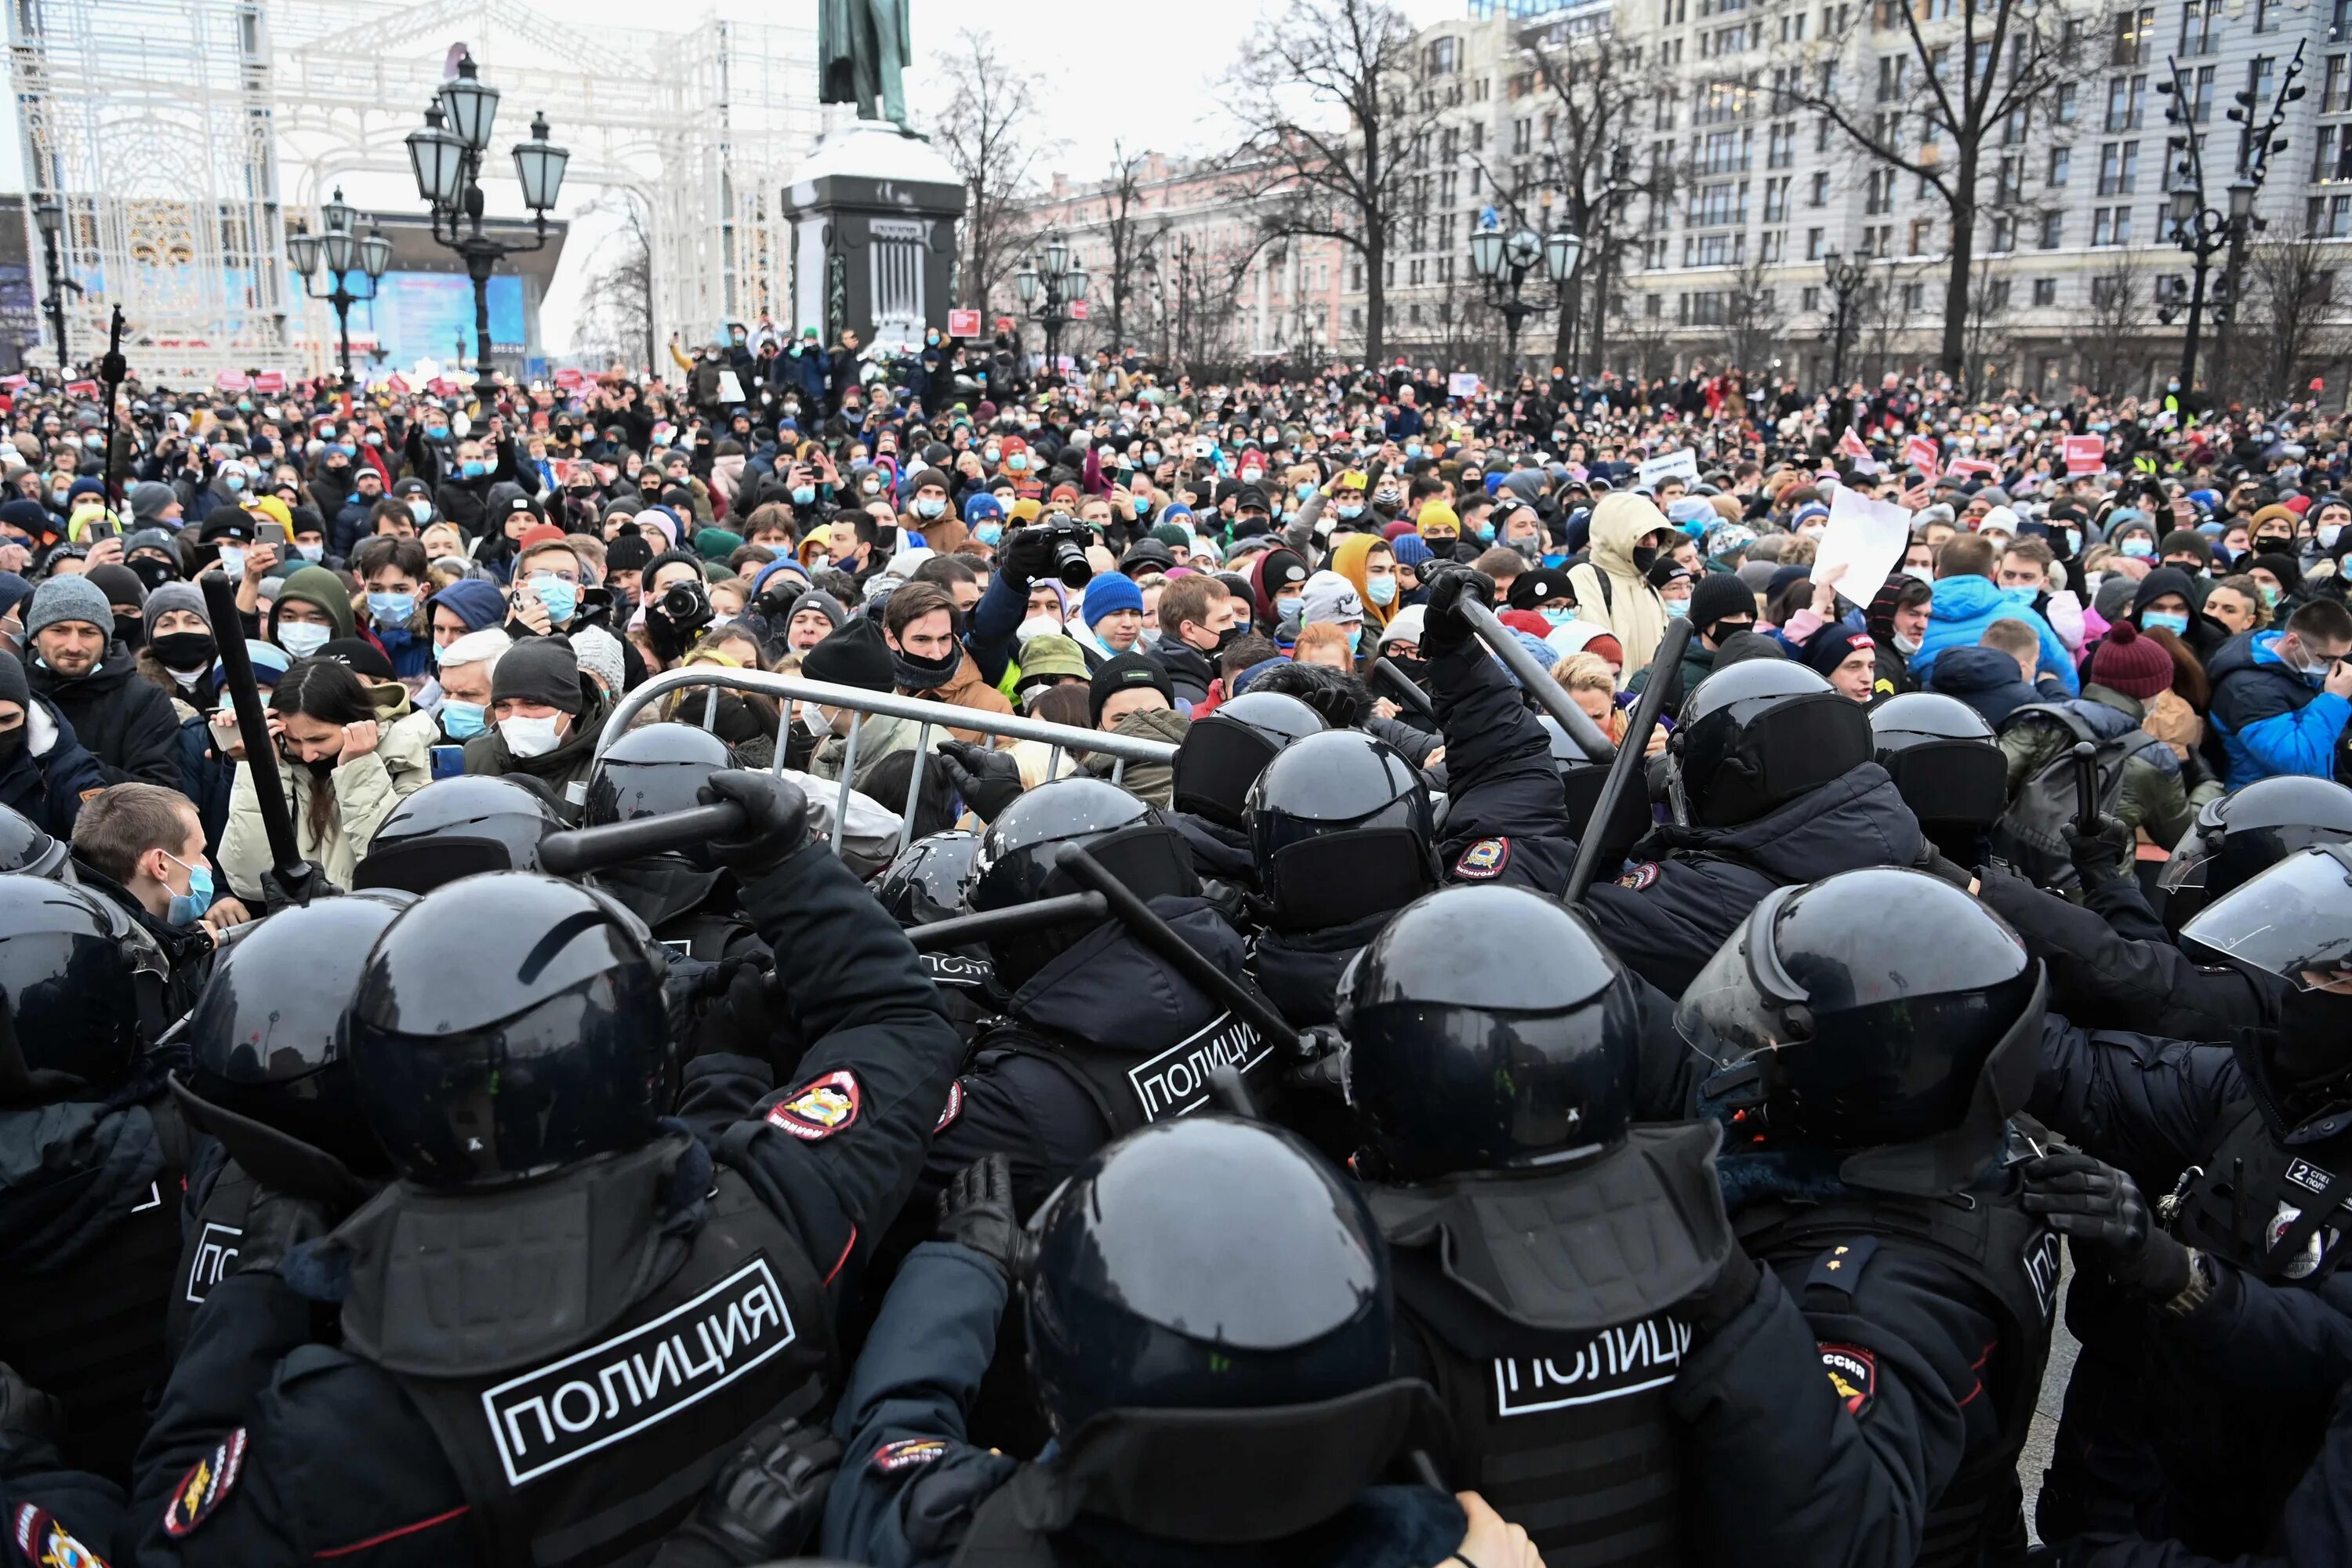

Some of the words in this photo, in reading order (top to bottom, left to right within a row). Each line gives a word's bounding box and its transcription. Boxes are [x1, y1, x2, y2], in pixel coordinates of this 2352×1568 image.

[1143, 1022, 1261, 1112] ПОЛИЦИ
[2293, 1164, 2309, 1181] 2
[2305, 1177, 2327, 1191] ПОЛ
[503, 1283, 780, 1457] ПОЛИЦИЯ
[1822, 1354, 1866, 1381] ССИЯ
